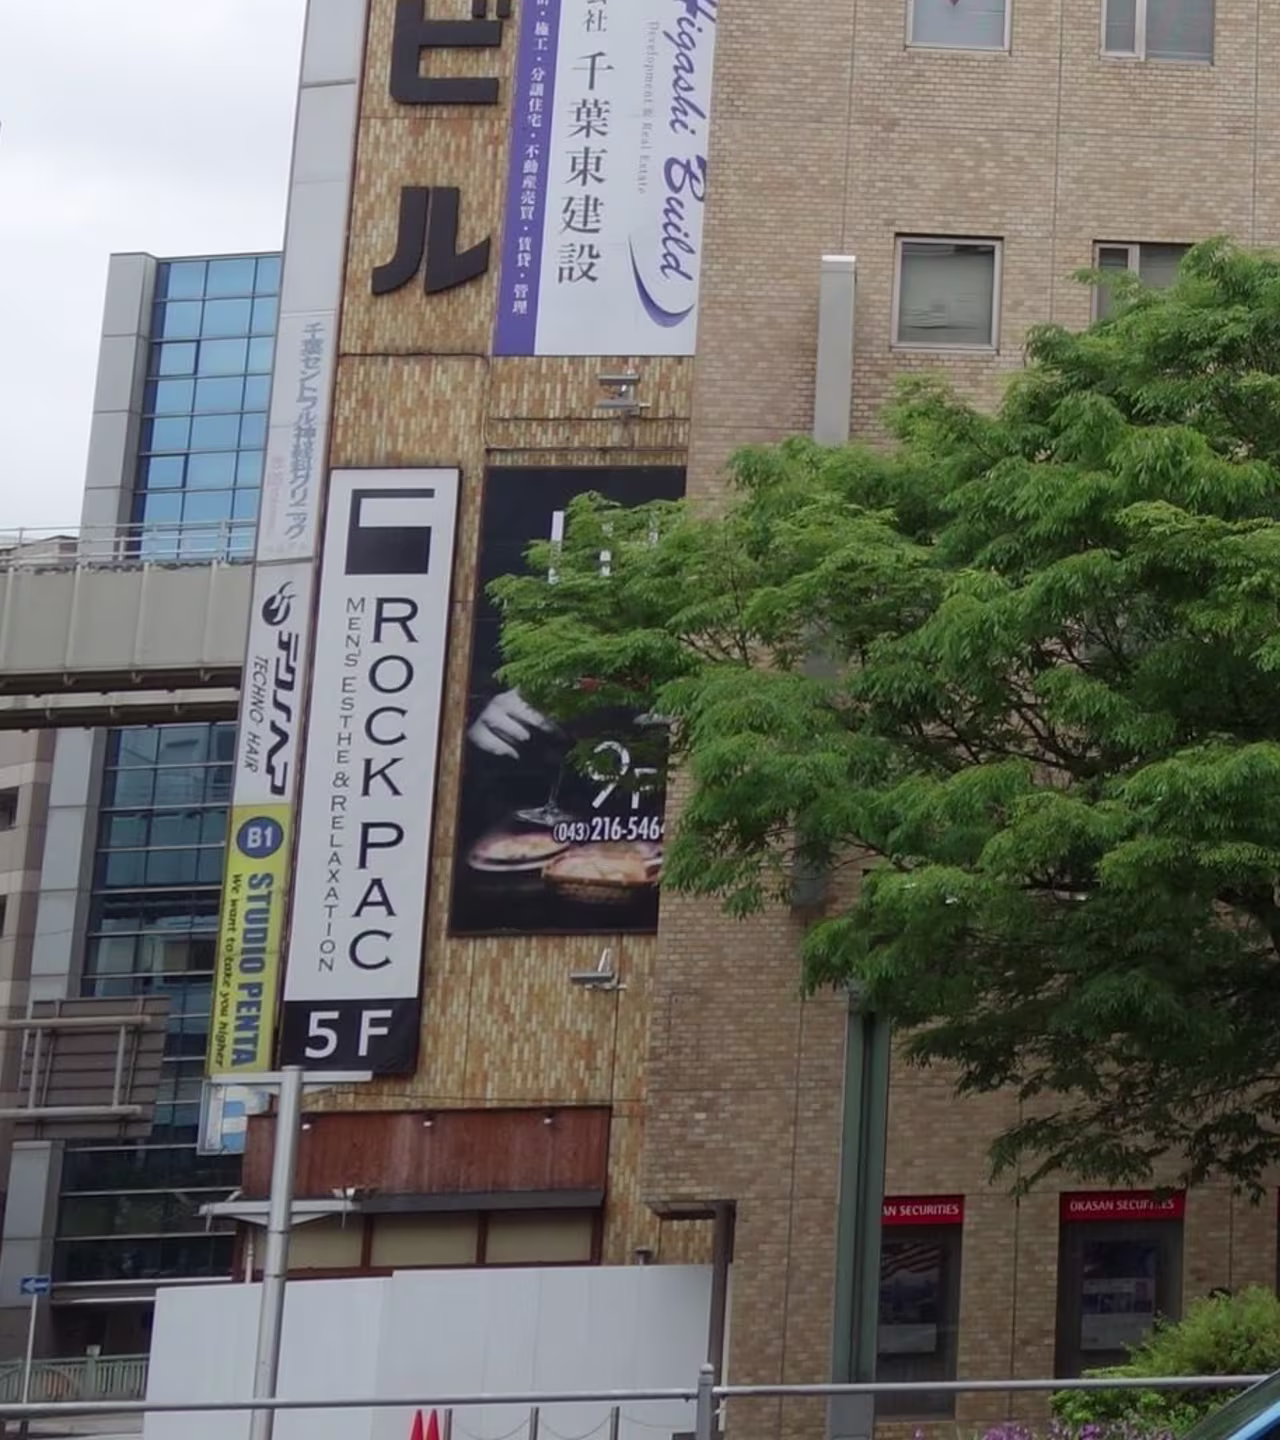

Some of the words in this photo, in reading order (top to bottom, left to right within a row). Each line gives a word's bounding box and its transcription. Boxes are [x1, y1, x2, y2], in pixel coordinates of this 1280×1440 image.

[556, 51, 615, 284] 千葉東建設
[660, 155, 708, 282] Build
[249, 655, 268, 725] TECHNO
[360, 596, 419, 797] ROCK
[243, 731, 261, 774] HAIR
[247, 826, 273, 849] B1
[317, 795, 347, 973] RELAXATION
[238, 872, 274, 975] STUDIO
[348, 821, 405, 971] PAC
[231, 981, 264, 1067] PENTA
[900, 1204, 959, 1216] SECURITIES
[1069, 1200, 1113, 1212] OKASAN
